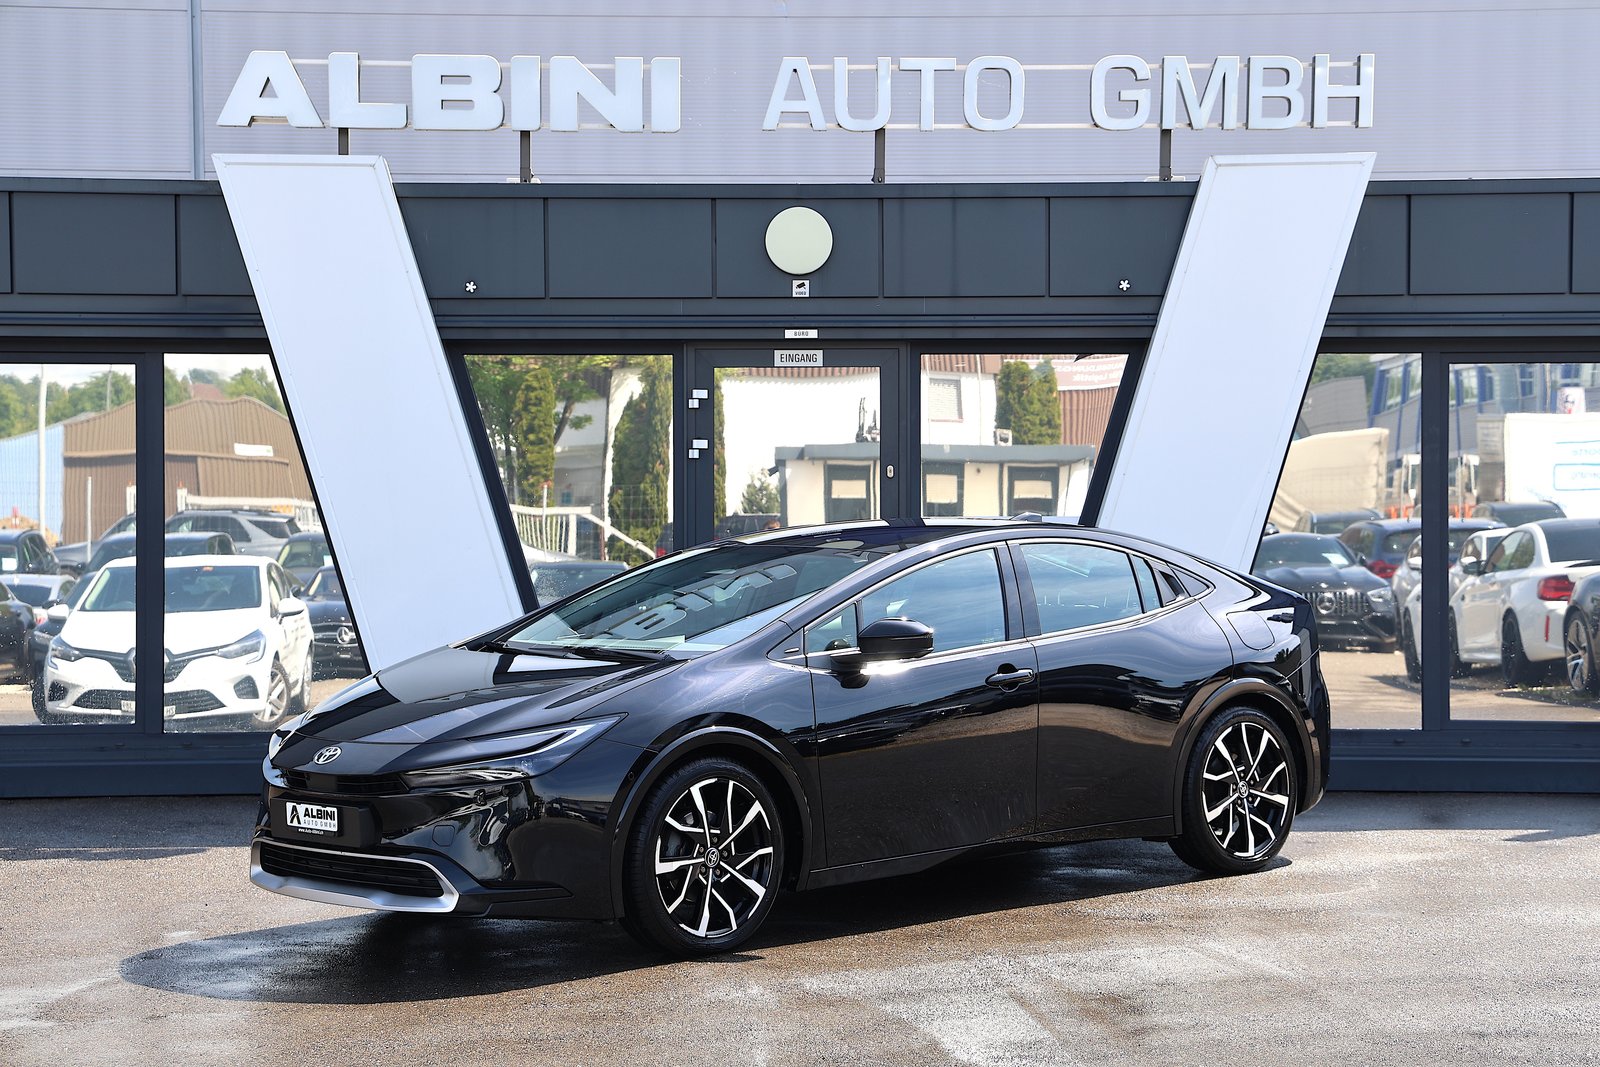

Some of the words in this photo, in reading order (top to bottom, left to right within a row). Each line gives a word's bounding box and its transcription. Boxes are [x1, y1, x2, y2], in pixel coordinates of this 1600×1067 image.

[216, 50, 681, 133] ALBINI
[762, 55, 1025, 132] AUTO
[1090, 53, 1375, 132] GMBH
[780, 353, 818, 363] EINGANG
[304, 807, 335, 821] ALBINI
